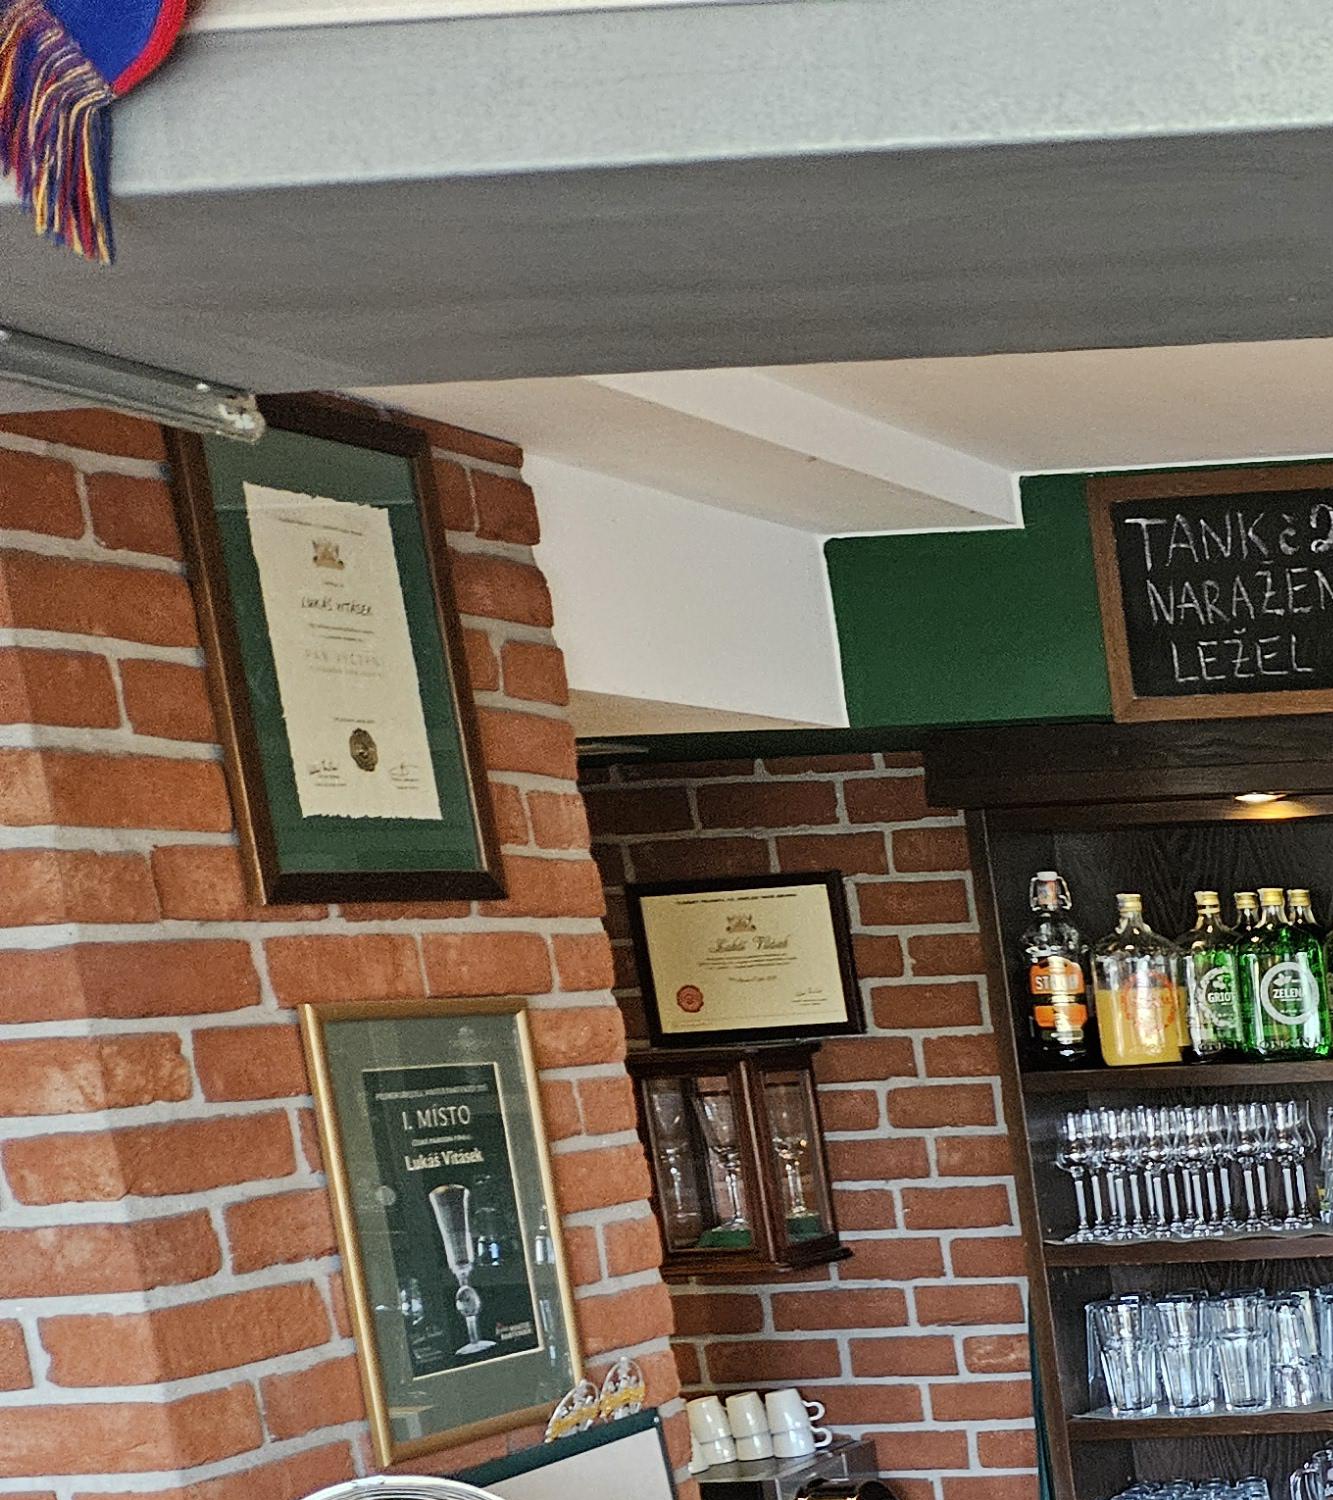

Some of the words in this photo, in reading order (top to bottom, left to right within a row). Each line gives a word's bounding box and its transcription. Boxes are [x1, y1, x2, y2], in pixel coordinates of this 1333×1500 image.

[1125, 511, 1268, 572] TANK
[1170, 628, 1315, 683] LEŽEL
[1273, 986, 1306, 1000] ZELEN
[416, 1103, 471, 1129] MÍSTO
